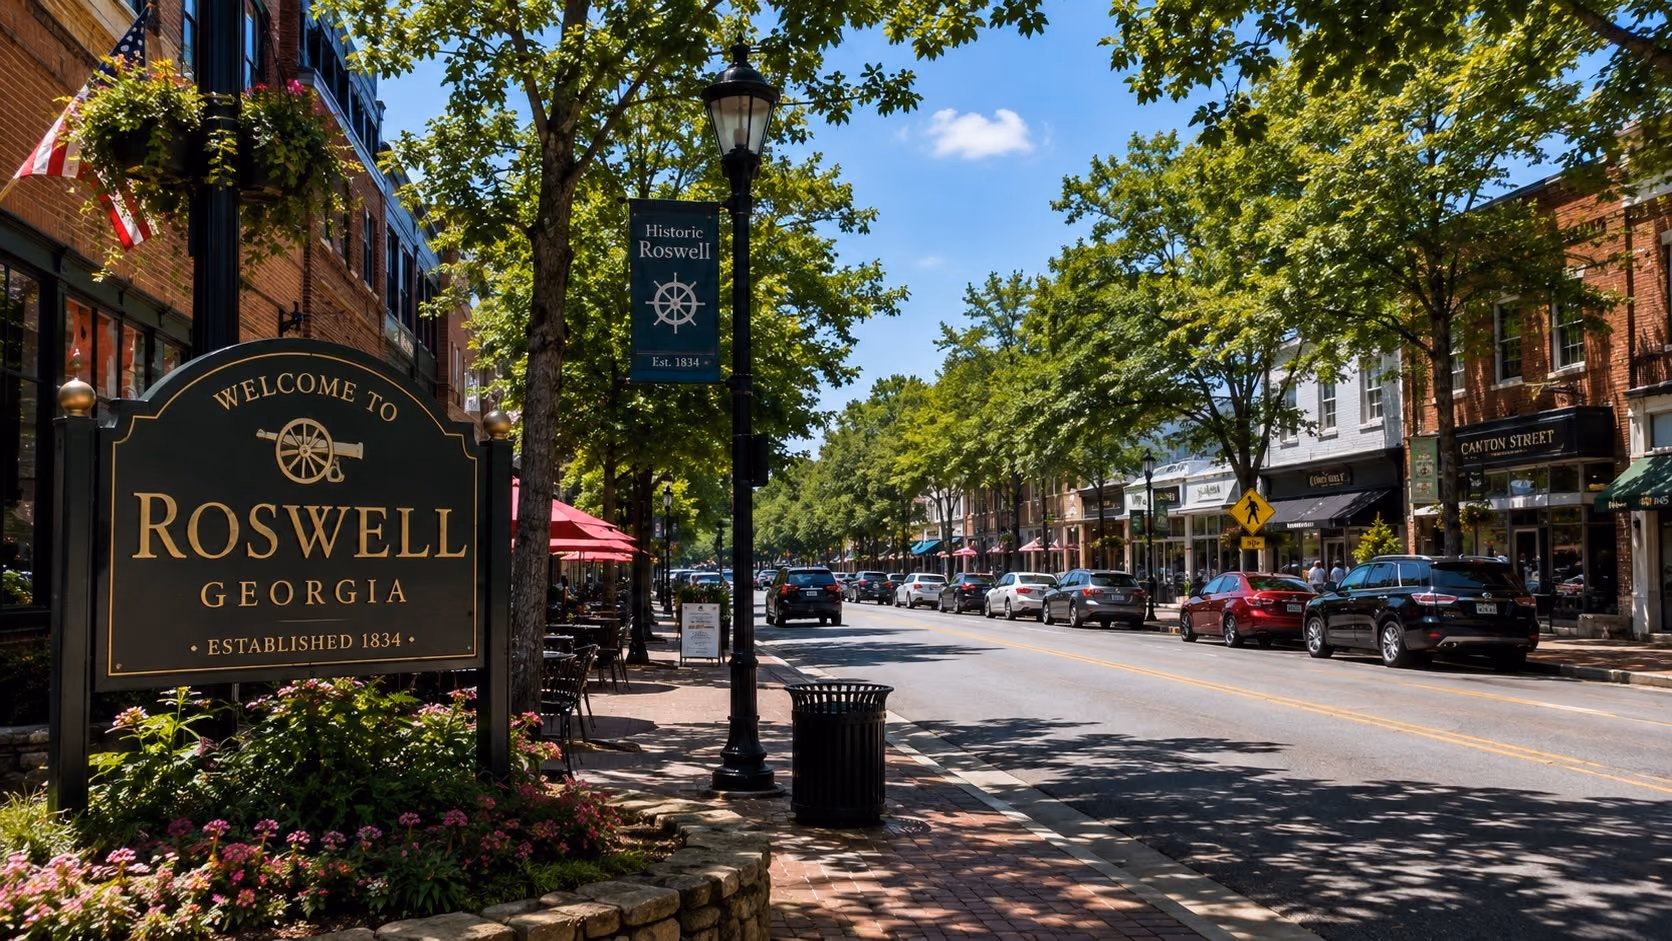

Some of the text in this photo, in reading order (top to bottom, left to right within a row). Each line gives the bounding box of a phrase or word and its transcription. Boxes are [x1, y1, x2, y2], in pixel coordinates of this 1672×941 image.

[645, 224, 704, 239] Historic
[639, 240, 711, 260] Roswell
[652, 356, 700, 368] Est. 1834
[213, 372, 398, 423] WELCOME TO
[1461, 429, 1555, 455] CANTON STREET
[132, 492, 468, 560] ROSWELL
[200, 578, 407, 608] GEORGIA
[207, 632, 402, 656] ESTABLISHED 1834
